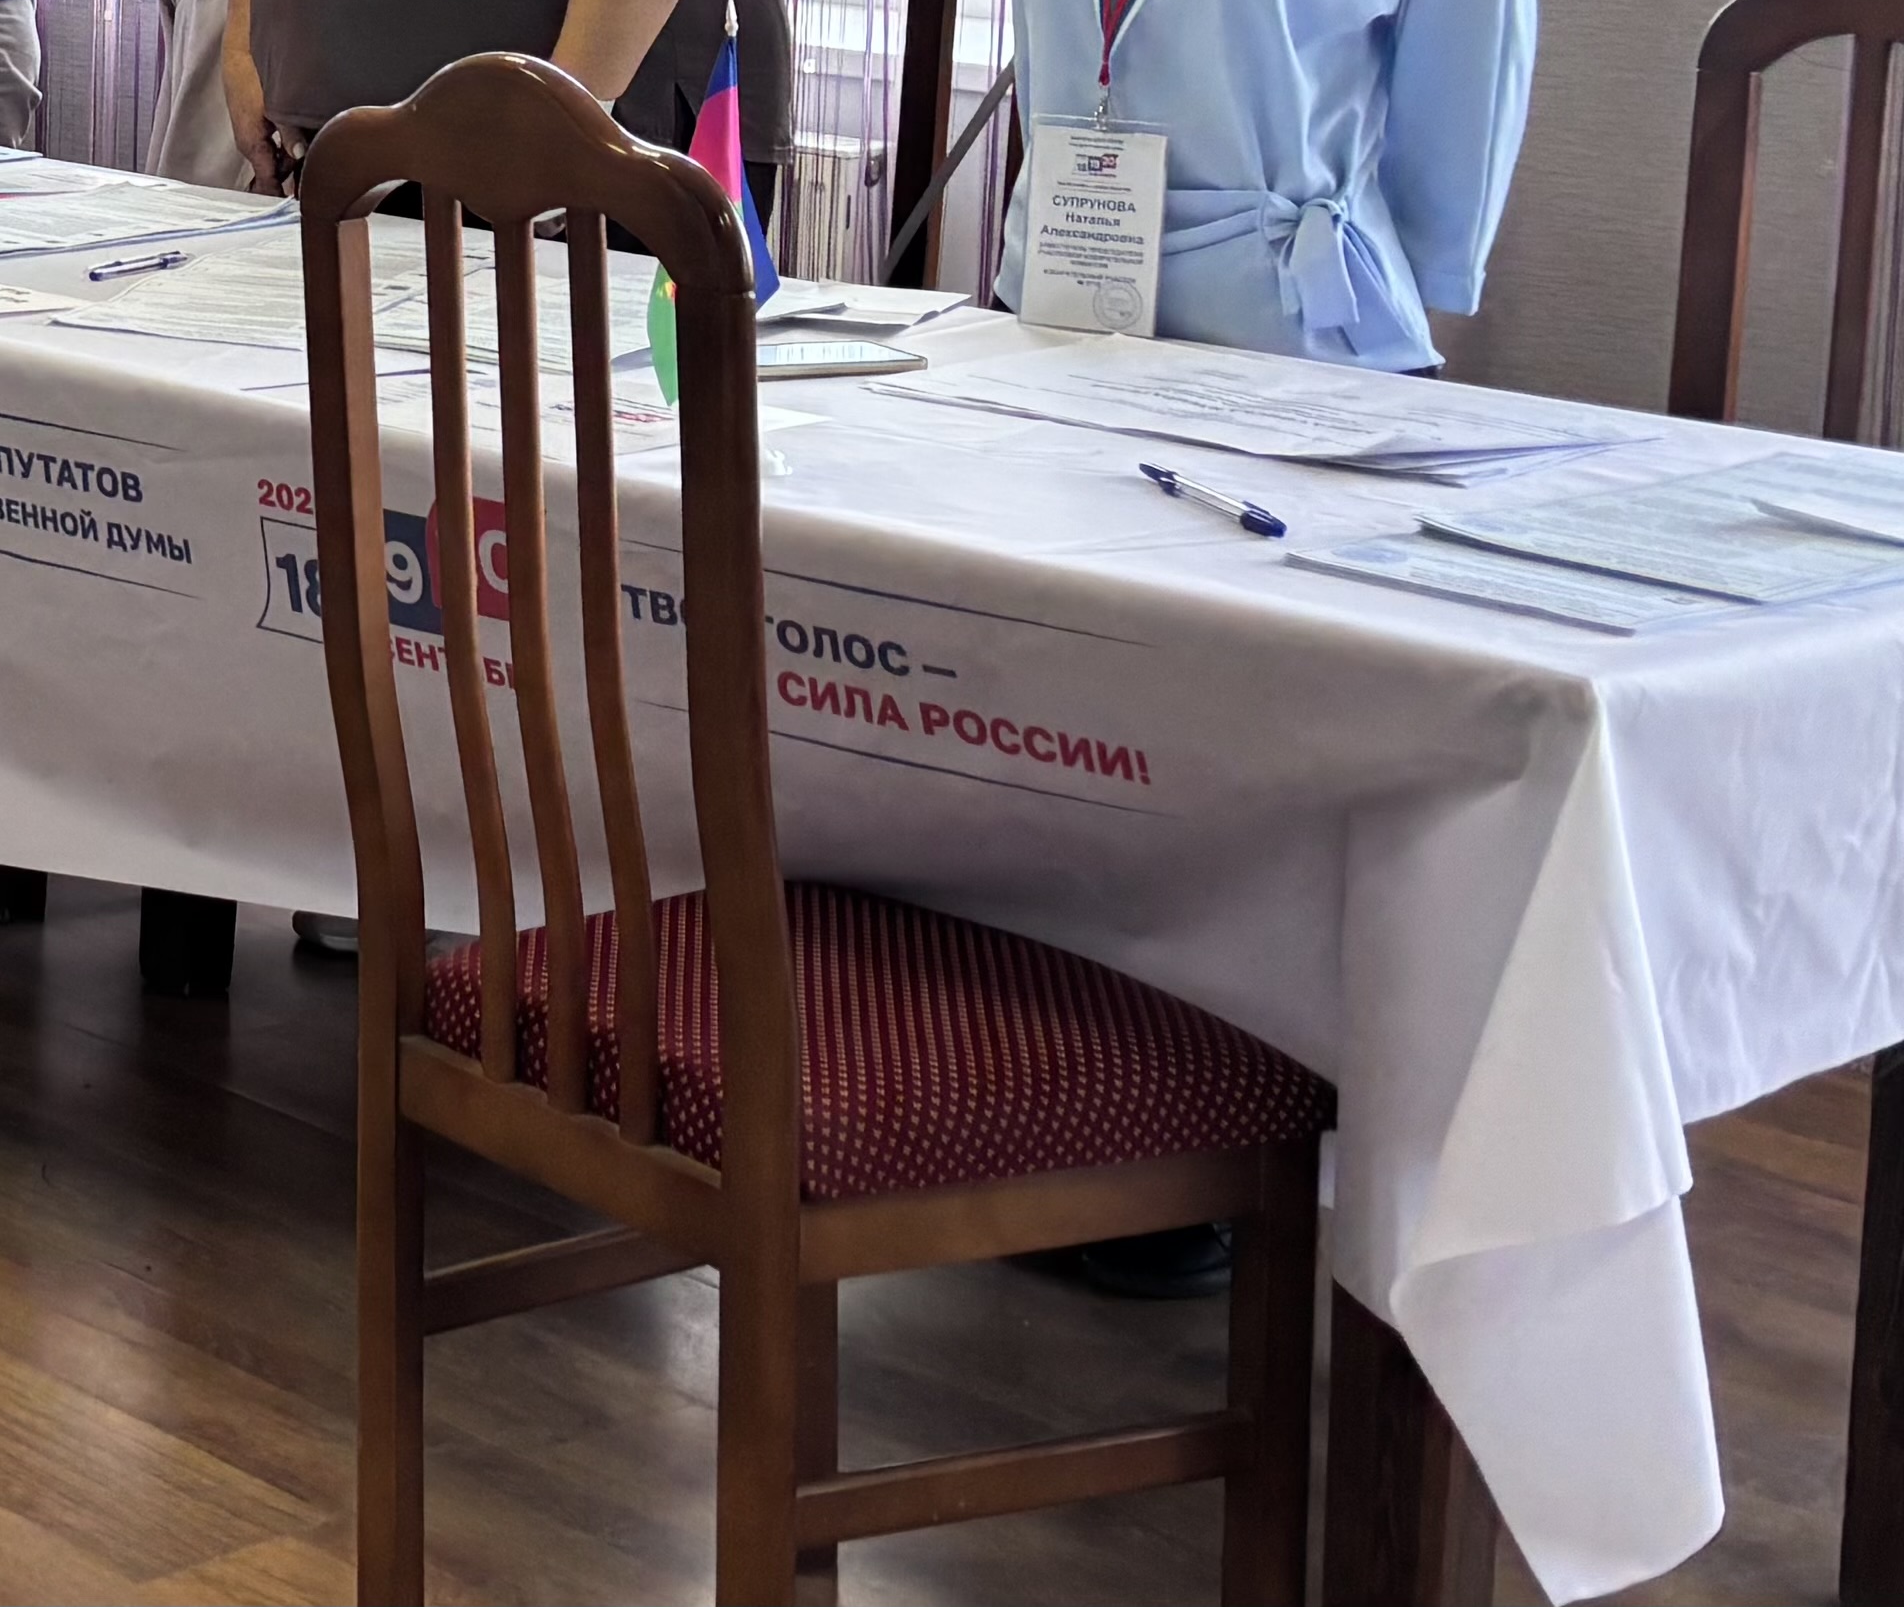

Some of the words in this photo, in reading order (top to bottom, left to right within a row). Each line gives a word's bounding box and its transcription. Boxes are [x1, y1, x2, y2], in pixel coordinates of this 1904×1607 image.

[1052, 195, 1136, 213] СУПРУНОВА
[1065, 212, 1121, 226] Наталья
[1040, 224, 1144, 245] Александровна
[257, 478, 314, 515] 202
[106, 521, 192, 564] ДУМЫ
[621, 583, 686, 627] ТВ
[765, 615, 911, 677] ОЛОС
[777, 670, 910, 733] СИЛА
[920, 700, 1152, 786] РОССИИ!
